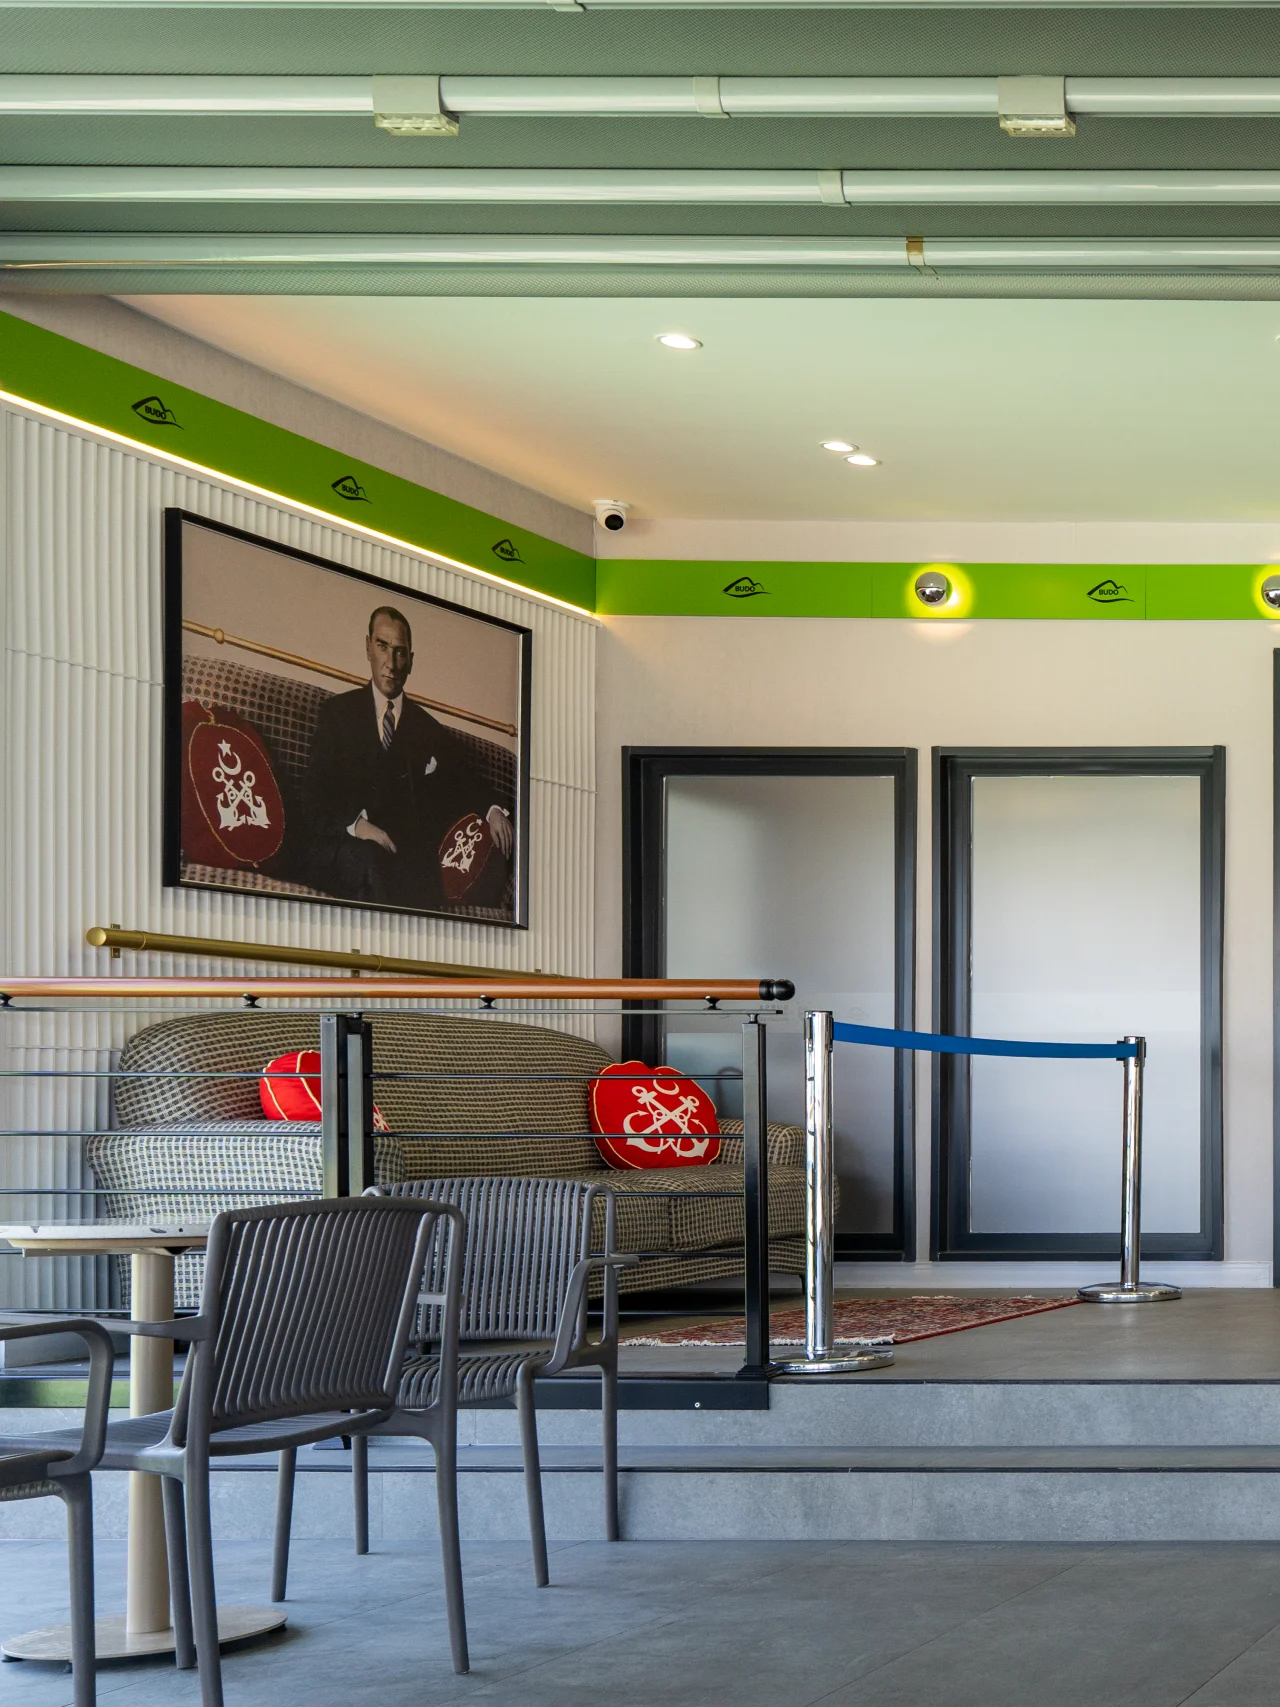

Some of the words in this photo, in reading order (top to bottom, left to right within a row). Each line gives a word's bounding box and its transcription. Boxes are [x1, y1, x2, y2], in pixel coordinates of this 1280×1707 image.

[145, 406, 166, 420] BUDO
[342, 484, 360, 496] BUDO
[500, 546, 515, 557] BUDO
